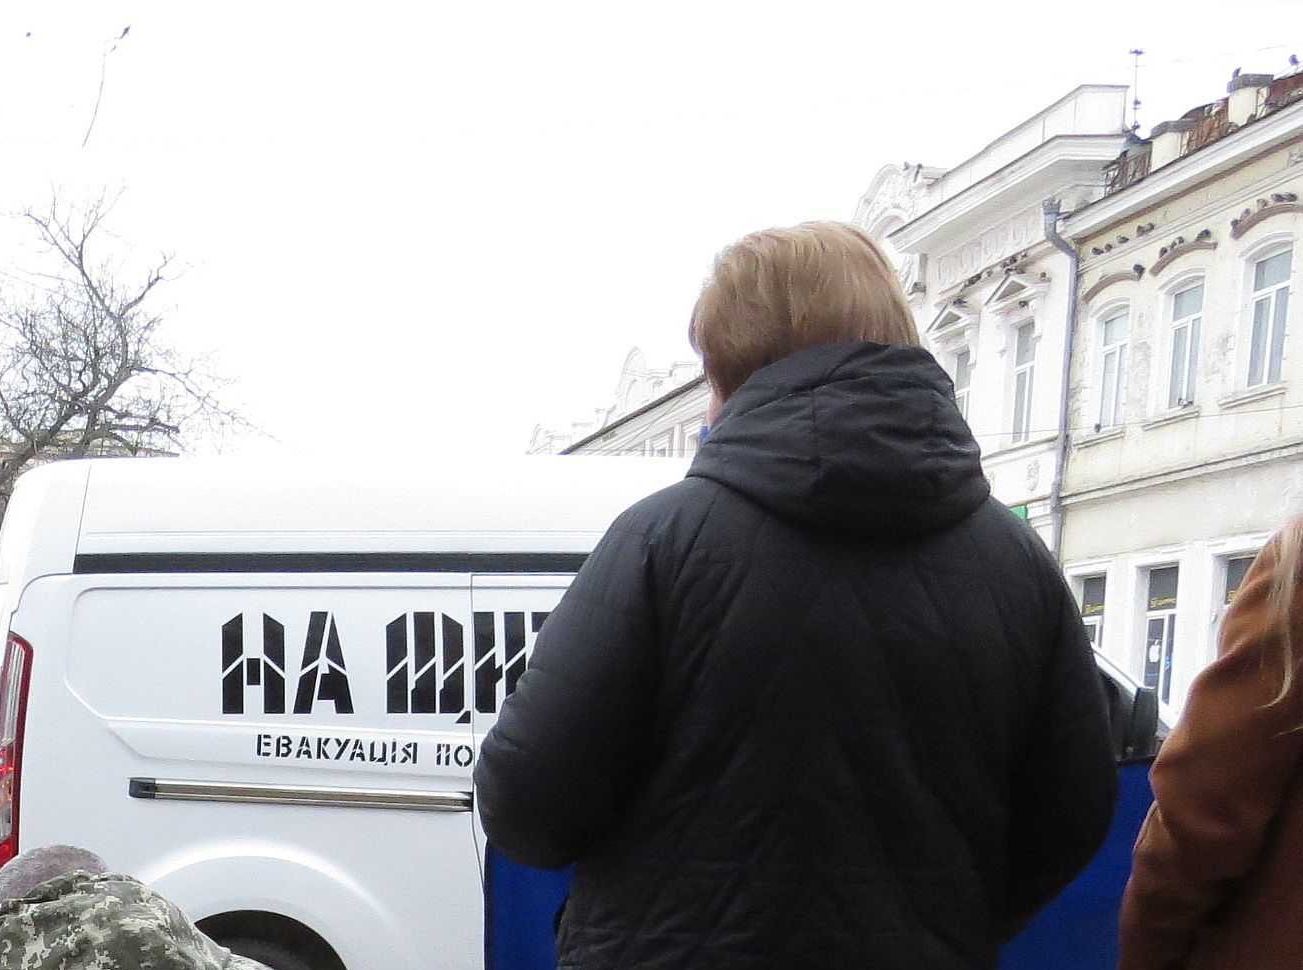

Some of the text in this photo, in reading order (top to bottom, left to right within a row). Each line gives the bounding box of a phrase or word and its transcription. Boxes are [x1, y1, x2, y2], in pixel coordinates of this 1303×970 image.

[221, 610, 552, 724] НА ЩИ
[256, 733, 474, 768] ЕВАКУАЦІЯ ПО
